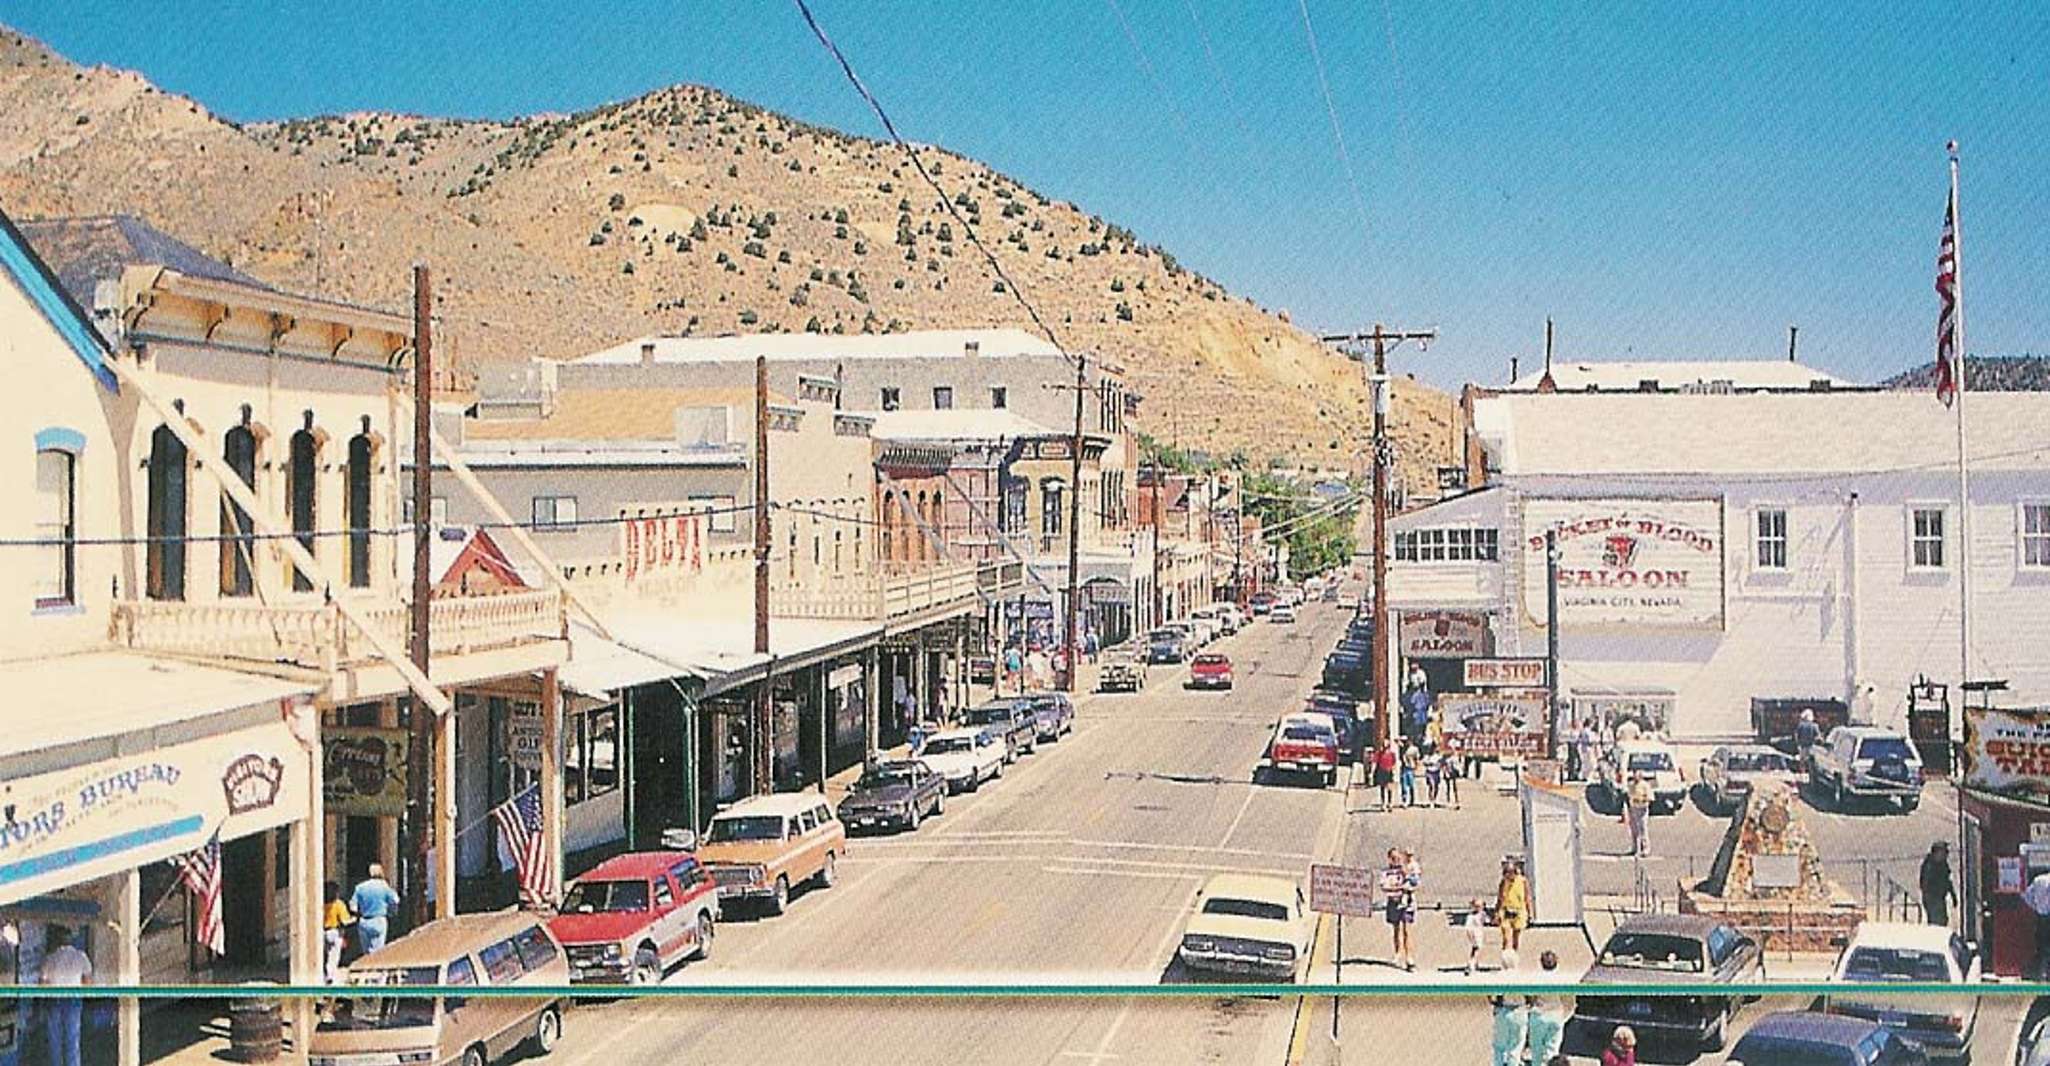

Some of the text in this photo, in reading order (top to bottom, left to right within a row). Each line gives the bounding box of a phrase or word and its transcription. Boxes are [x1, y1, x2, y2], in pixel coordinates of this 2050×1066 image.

[1637, 519, 1713, 552] BLOOD
[626, 517, 702, 581] DELTA
[1557, 569, 1690, 588] SALOON
[1410, 639, 1473, 651] SALOON
[1468, 663, 1541, 679] BUS STOP
[79, 763, 181, 809] BUREAU
